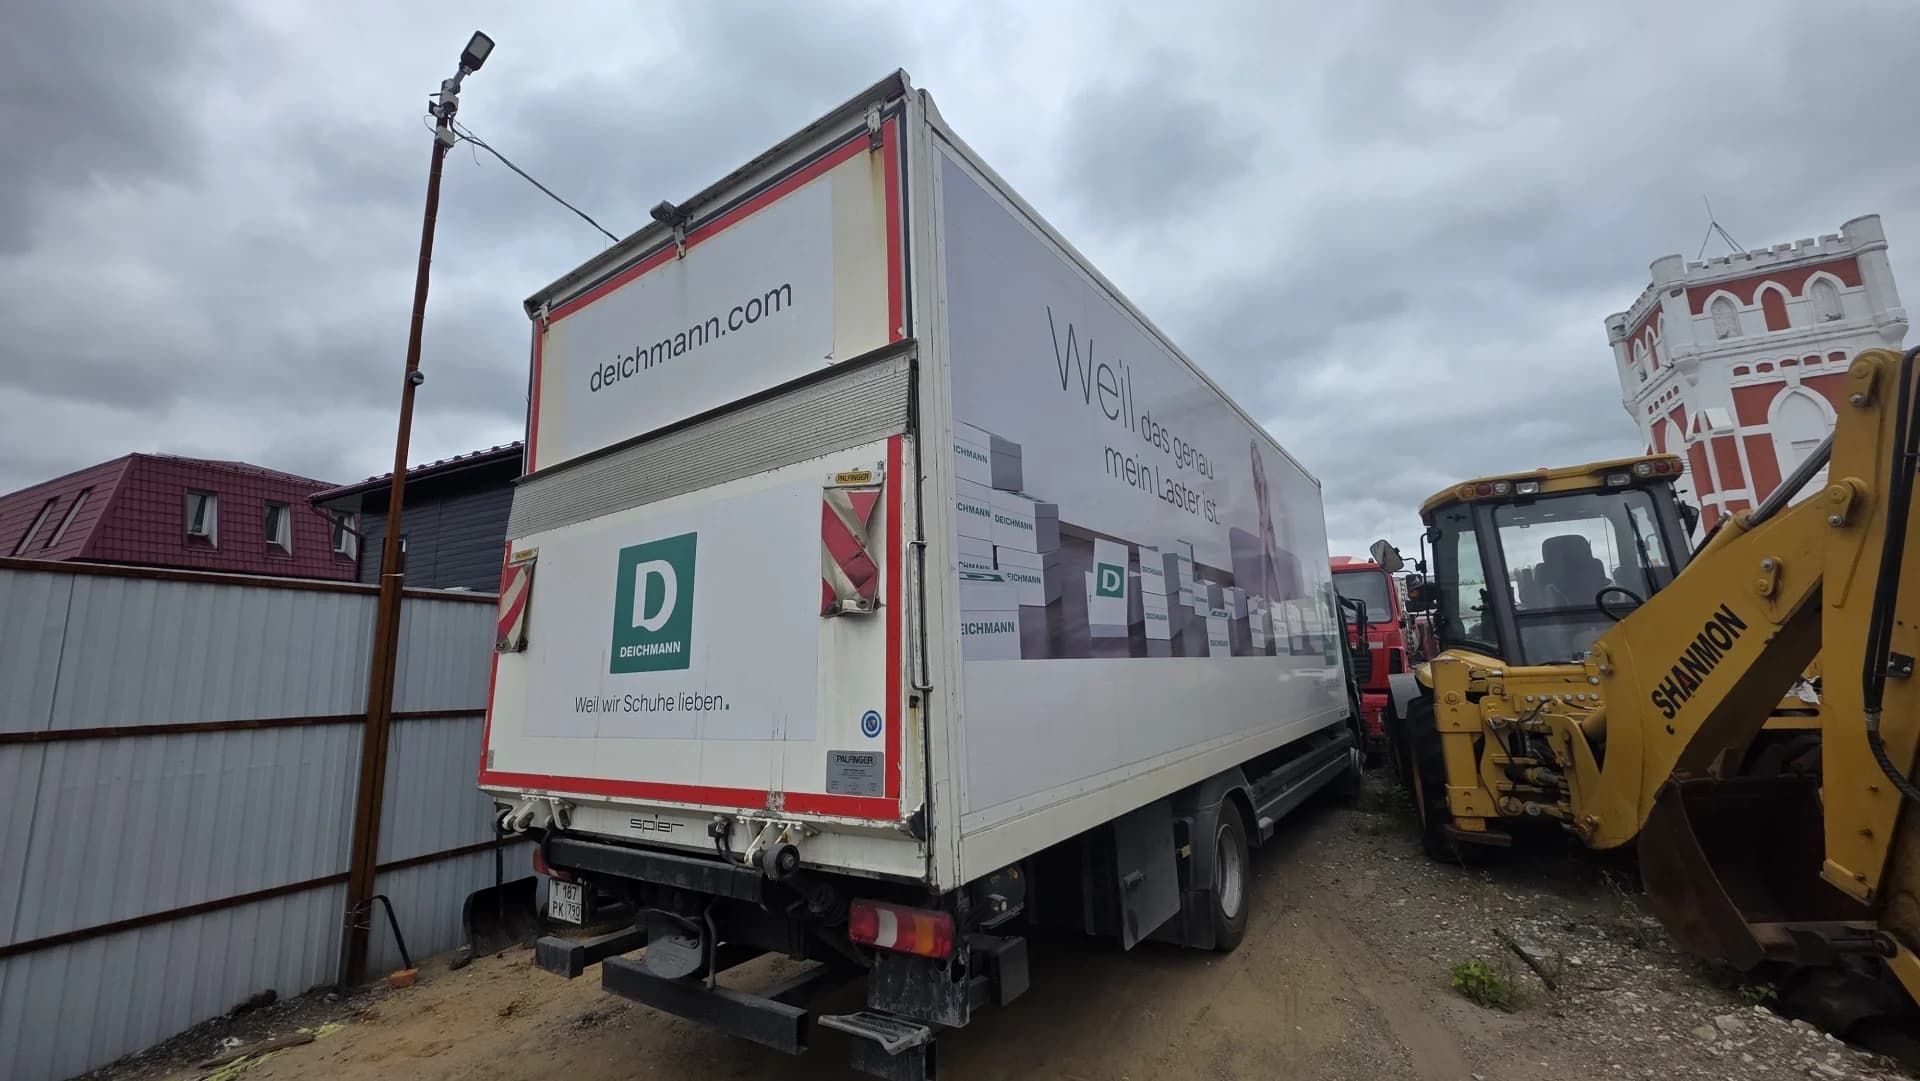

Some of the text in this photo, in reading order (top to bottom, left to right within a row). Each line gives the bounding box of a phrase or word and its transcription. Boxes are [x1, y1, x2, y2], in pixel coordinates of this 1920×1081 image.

[590, 283, 792, 392] deichmann.com
[1046, 305, 1214, 480] Weil das genau
[837, 472, 870, 481] PALFINGER
[1105, 445, 1152, 494] mein
[1156, 465, 1200, 515] Laster
[994, 514, 1033, 531] DEICHMANN
[1102, 569, 1121, 592] D
[632, 560, 678, 632] D
[620, 641, 681, 658] DEICHMANN
[1651, 602, 1748, 720] SHANMON
[575, 691, 730, 713] Weil wir Schuhe lieben.
[836, 754, 873, 765] PALFINGER
[630, 814, 684, 833] spier
[563, 885, 577, 900] 187
